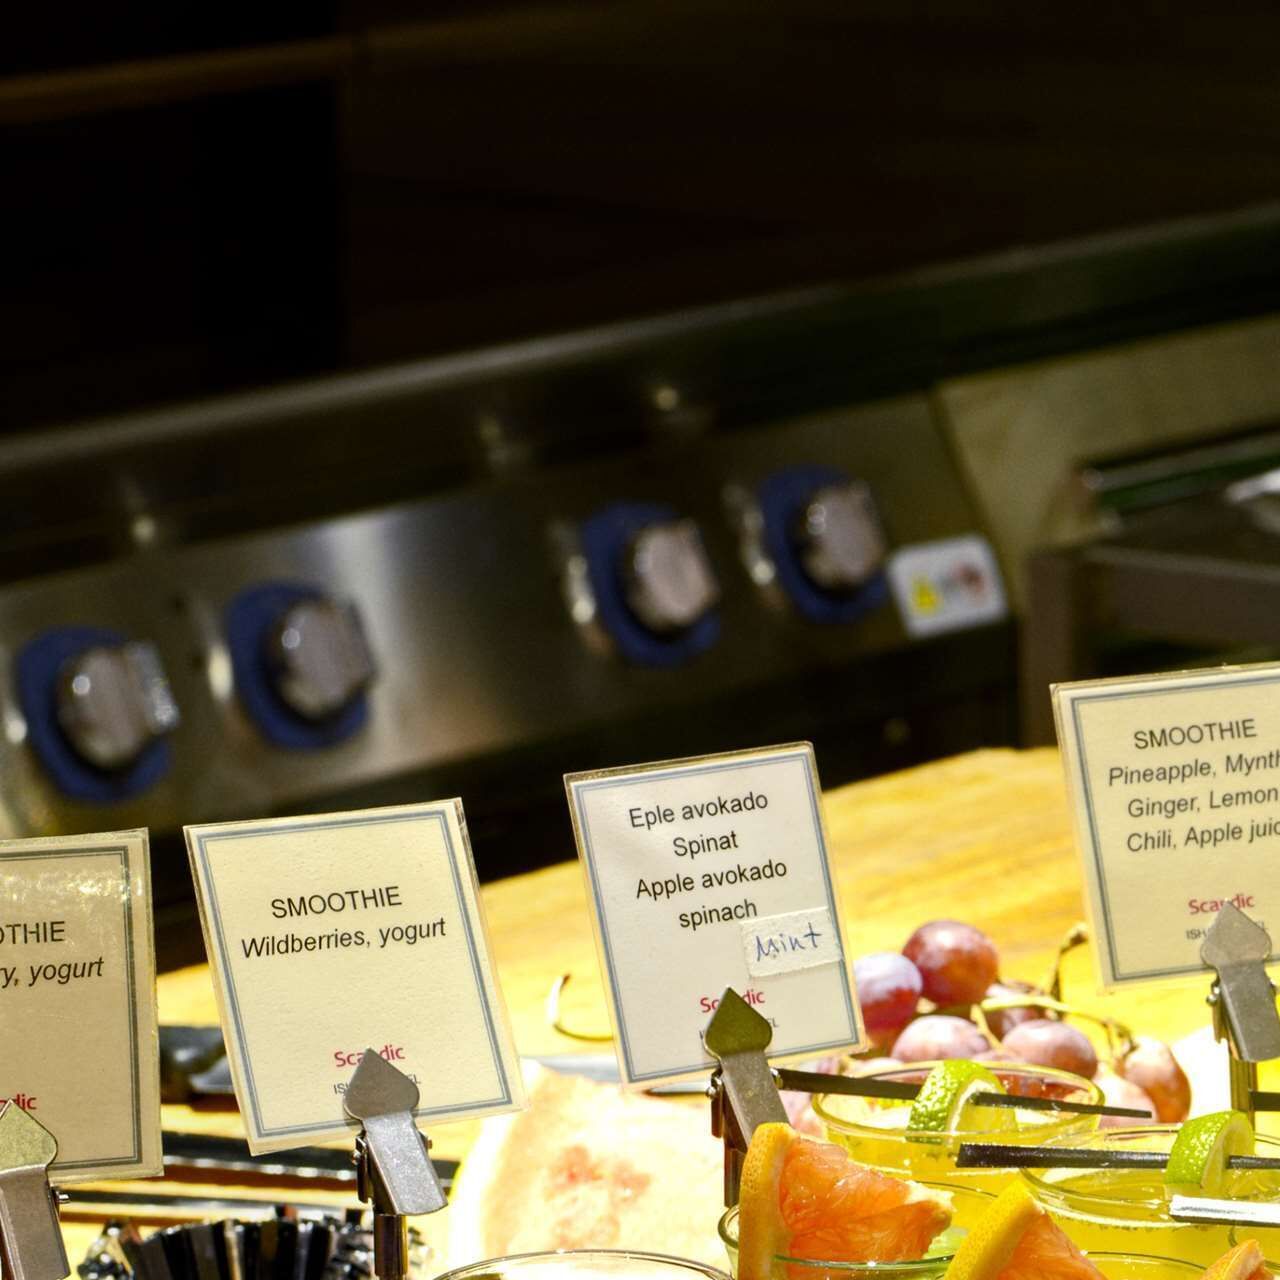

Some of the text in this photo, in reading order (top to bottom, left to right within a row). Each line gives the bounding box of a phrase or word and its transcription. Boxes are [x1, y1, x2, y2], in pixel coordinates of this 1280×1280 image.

[1134, 719, 1257, 750] SMOOTHIE
[1109, 758, 1217, 786] Pineapple,
[629, 791, 769, 831] Eple avokado
[1128, 795, 1201, 819] Ginger,
[673, 830, 739, 859] Spinat
[1127, 829, 1177, 852] Chili,
[1184, 822, 1243, 848] Apple
[636, 859, 788, 901] Apple avokado
[271, 886, 403, 919] SMOOTHIE
[679, 899, 758, 931] spinach
[1188, 893, 1256, 915] Scadic
[241, 917, 447, 959] Wildberries, yogurt
[755, 922, 823, 962] Mint
[28, 956, 105, 988] yogurt
[700, 988, 766, 1014] Scdic
[333, 1044, 406, 1068] Scadic
